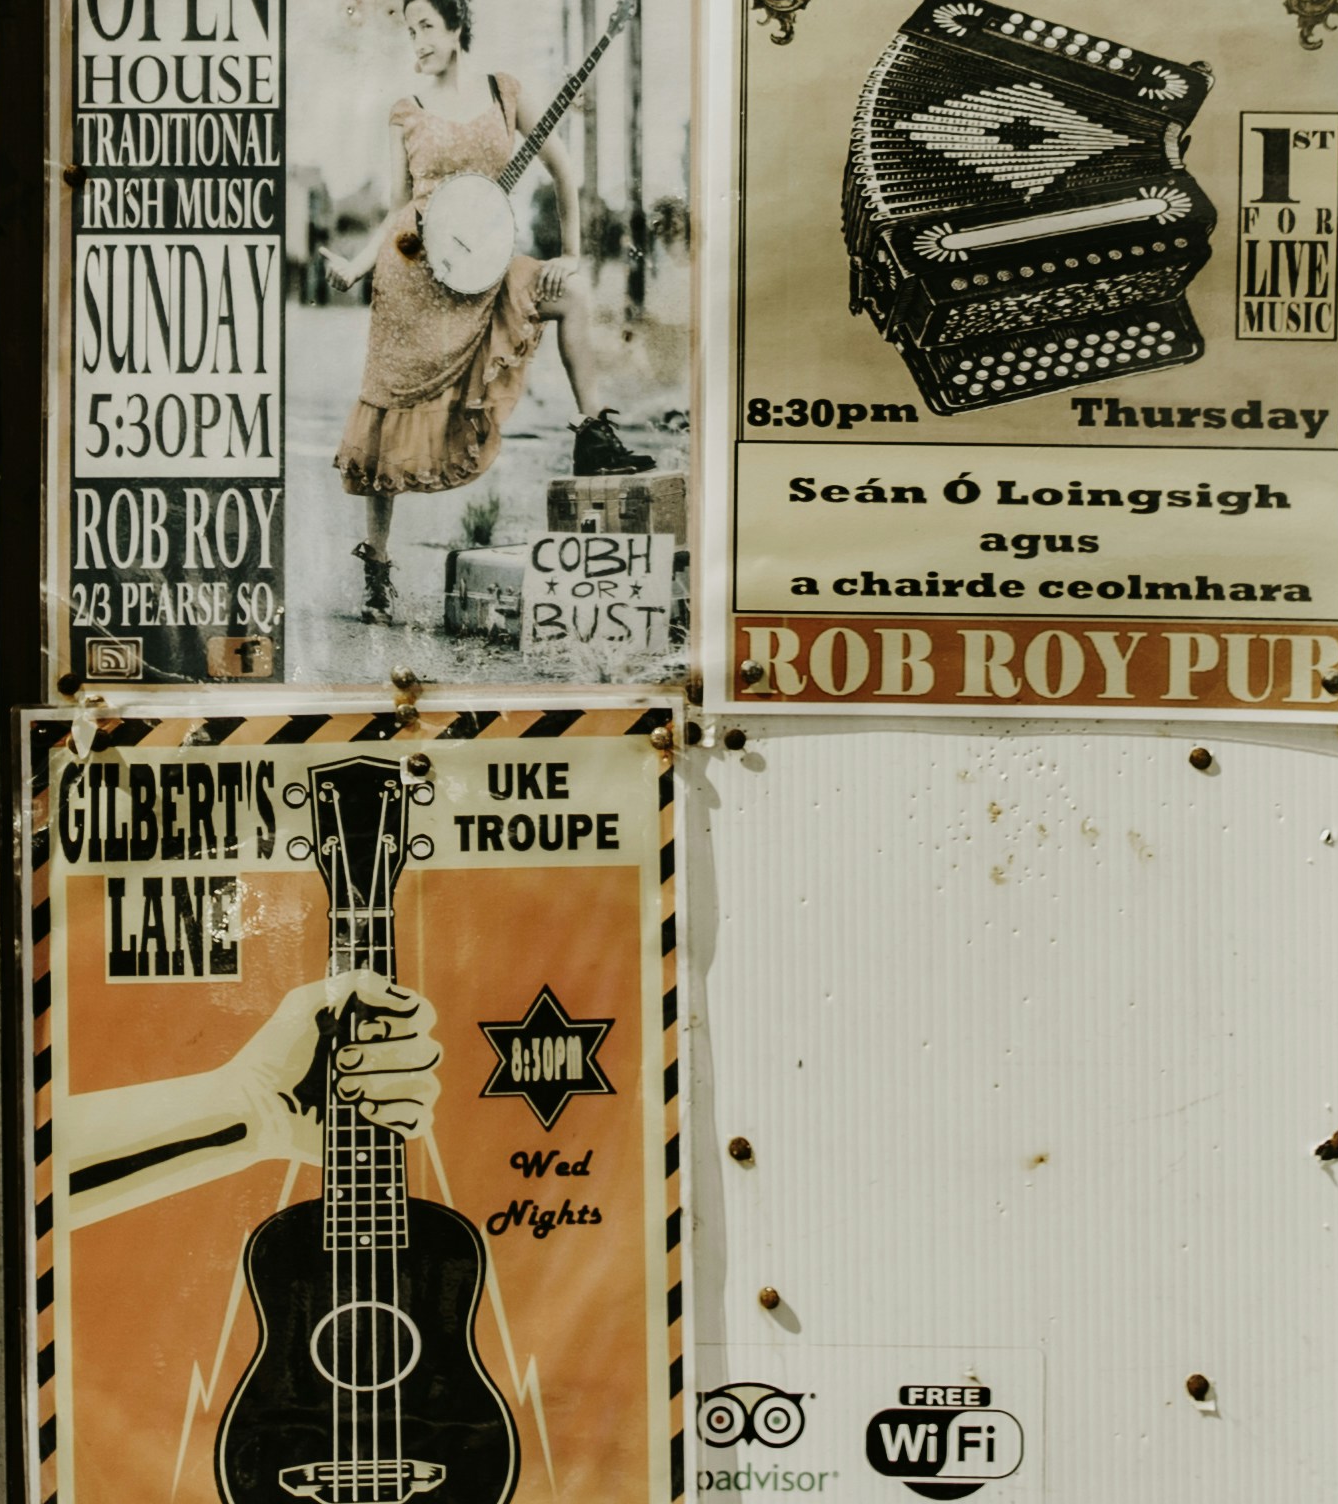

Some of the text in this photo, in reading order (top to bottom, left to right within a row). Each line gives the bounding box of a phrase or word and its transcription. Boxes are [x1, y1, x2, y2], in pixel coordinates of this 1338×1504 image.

[84, 55, 274, 104] HOUSE
[77, 113, 280, 166] TRADITIONAL
[1250, 128, 1334, 203] 1ST
[81, 178, 274, 228] IRISH MUSIC
[1242, 207, 1333, 235] FOR
[1243, 240, 1328, 298] LIVE
[82, 244, 275, 376] SUNDAY
[1243, 302, 1332, 333] MUSIC
[86, 393, 272, 459] 5:30PM
[747, 397, 1330, 438] 8:30pm Thursday
[789, 472, 1291, 515] Seán Ó Loingsigh
[75, 487, 282, 570] ROB ROY
[979, 531, 1099, 559] agus
[532, 535, 651, 578] COBH
[72, 582, 111, 626] 2/3
[121, 582, 230, 626] PEARSE
[571, 580, 618, 598] OR
[790, 571, 1311, 602] a chairde ceolmhara
[533, 603, 666, 647] BUST
[741, 626, 935, 696] ROB
[956, 629, 1147, 700] ROY
[59, 760, 569, 864] GILBERT'S UKE
[454, 814, 620, 852] TROUPE
[108, 876, 240, 977] LANE
[512, 1036, 583, 1082] 8:30PM
[510, 1150, 593, 1178] Wed
[486, 1199, 602, 1239] Nights
[908, 1388, 981, 1405] FREE
